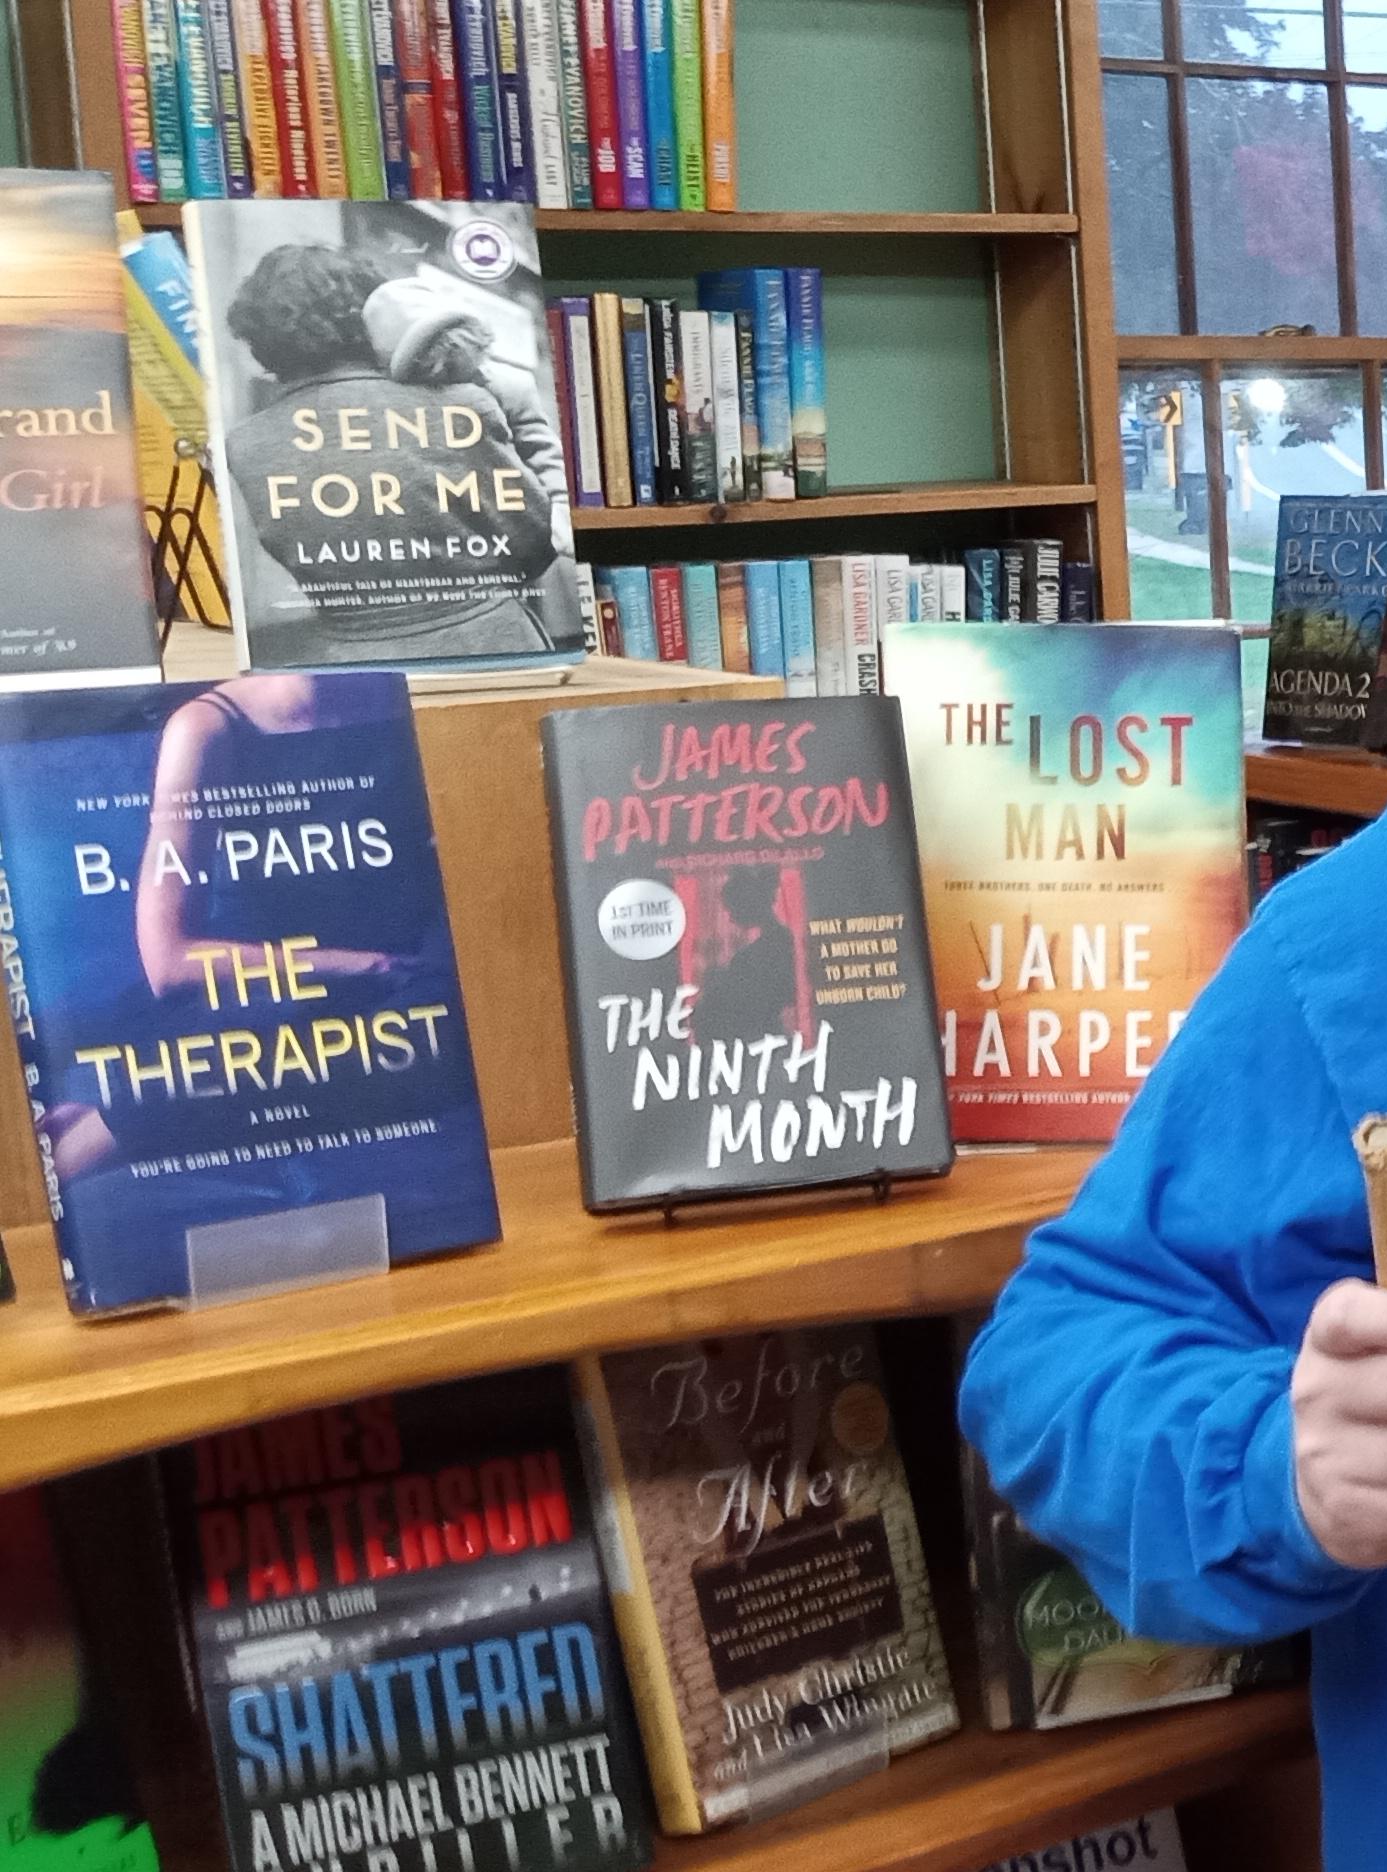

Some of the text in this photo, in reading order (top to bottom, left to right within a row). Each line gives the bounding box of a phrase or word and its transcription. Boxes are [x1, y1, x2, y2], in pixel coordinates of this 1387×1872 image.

[562, 57, 587, 144] EVANOVICH
[291, 405, 483, 450] SEND
[2, 465, 107, 511] Girl
[266, 468, 526, 519] FOR ME
[296, 534, 512, 565] LAUREN FOX
[1289, 509, 1384, 534] GLENN
[851, 562, 868, 588] LISA
[853, 592, 869, 645] GARDNER
[1270, 671, 1370, 699] AGENDA 2
[631, 720, 816, 791] JAMES
[939, 702, 1194, 786] THE LOST
[77, 798, 108, 812] NEW
[114, 795, 149, 808] YORK
[203, 783, 295, 802] BESTSELLING
[302, 778, 354, 794] AUTHOR
[208, 799, 310, 819] CLOSED DOORS
[580, 776, 890, 862] PATTERSON
[74, 818, 394, 895] B. A. PARIS
[1005, 803, 1127, 860] MAN
[611, 920, 673, 938] IN PRINT
[638, 899, 673, 917] TIME
[810, 919, 842, 935] WHAT
[186, 935, 328, 1010] THE
[820, 943, 829, 959] A
[831, 939, 879, 956] MOTHER
[825, 961, 898, 981] TO SAVE HER
[977, 923, 1151, 992] JANE
[597, 983, 698, 1055] THE
[816, 988, 864, 1005] UNBORN
[75, 1004, 449, 1109] THERAPIST
[632, 1020, 833, 1110] NINTH
[265, 1105, 310, 1121] NOVEL
[707, 1076, 917, 1169] MONTH
[235, 1147, 251, 1162] TO
[256, 1142, 291, 1159] NEED
[297, 1137, 313, 1152] TO
[317, 1132, 350, 1148] TALK
[355, 1129, 370, 1144] TO
[38, 1133, 64, 1221] PARIS
[650, 1342, 863, 1434] Before
[197, 1449, 572, 1611] PATTERSON
[693, 1451, 868, 1557] After
[228, 1621, 604, 1804] SHATTERED
[723, 1645, 913, 1746] Judy Christie
[249, 1733, 611, 1872] A MICHAEL BENNETT
